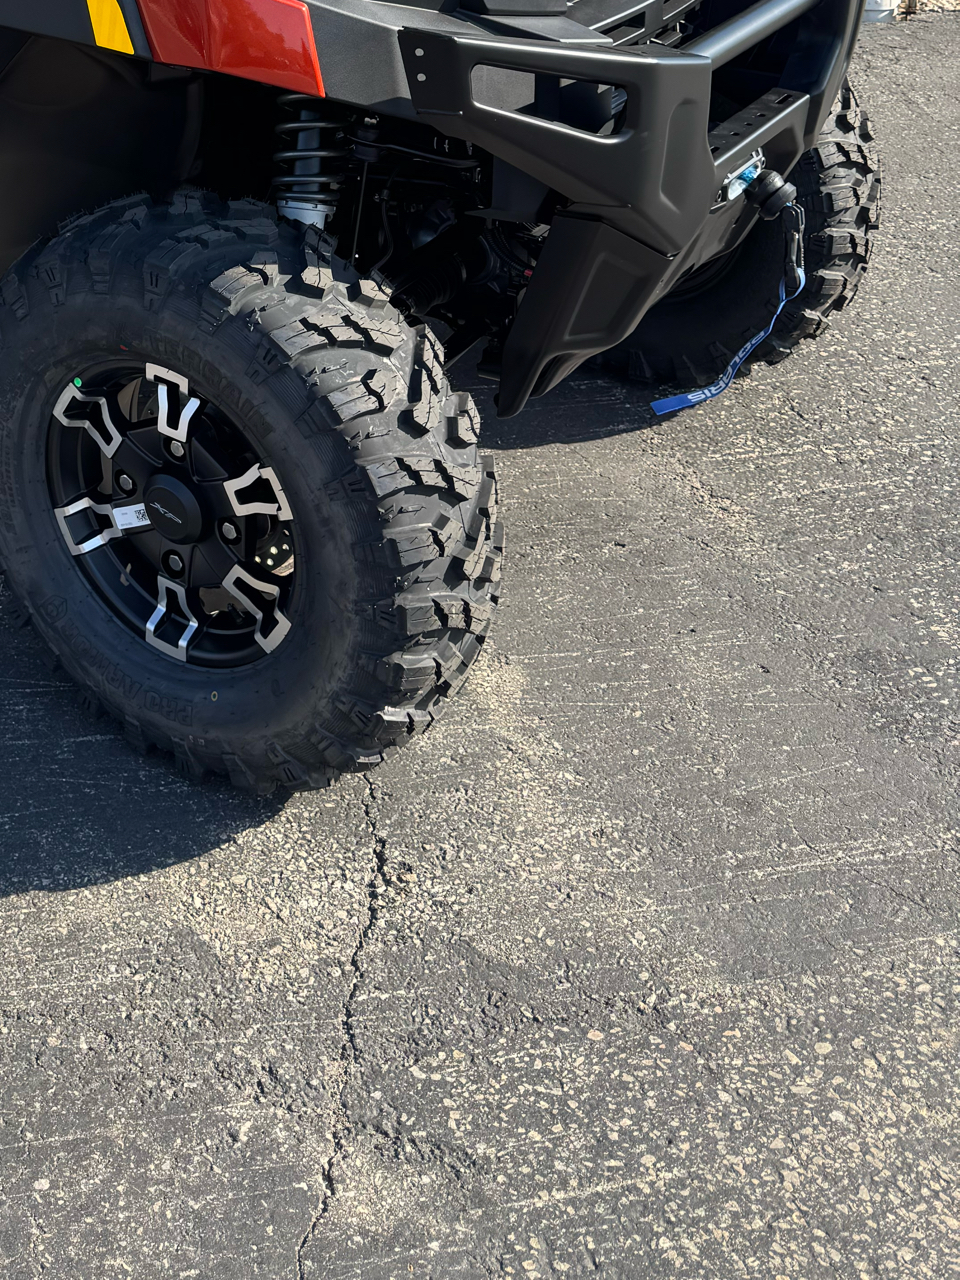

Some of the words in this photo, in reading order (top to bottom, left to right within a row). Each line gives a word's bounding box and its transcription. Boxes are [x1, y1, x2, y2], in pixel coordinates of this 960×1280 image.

[687, 331, 765, 402] POLARIS
[149, 501, 182, 524] XP
[60, 617, 144, 700] ARMOR
[143, 690, 193, 727] PRO
